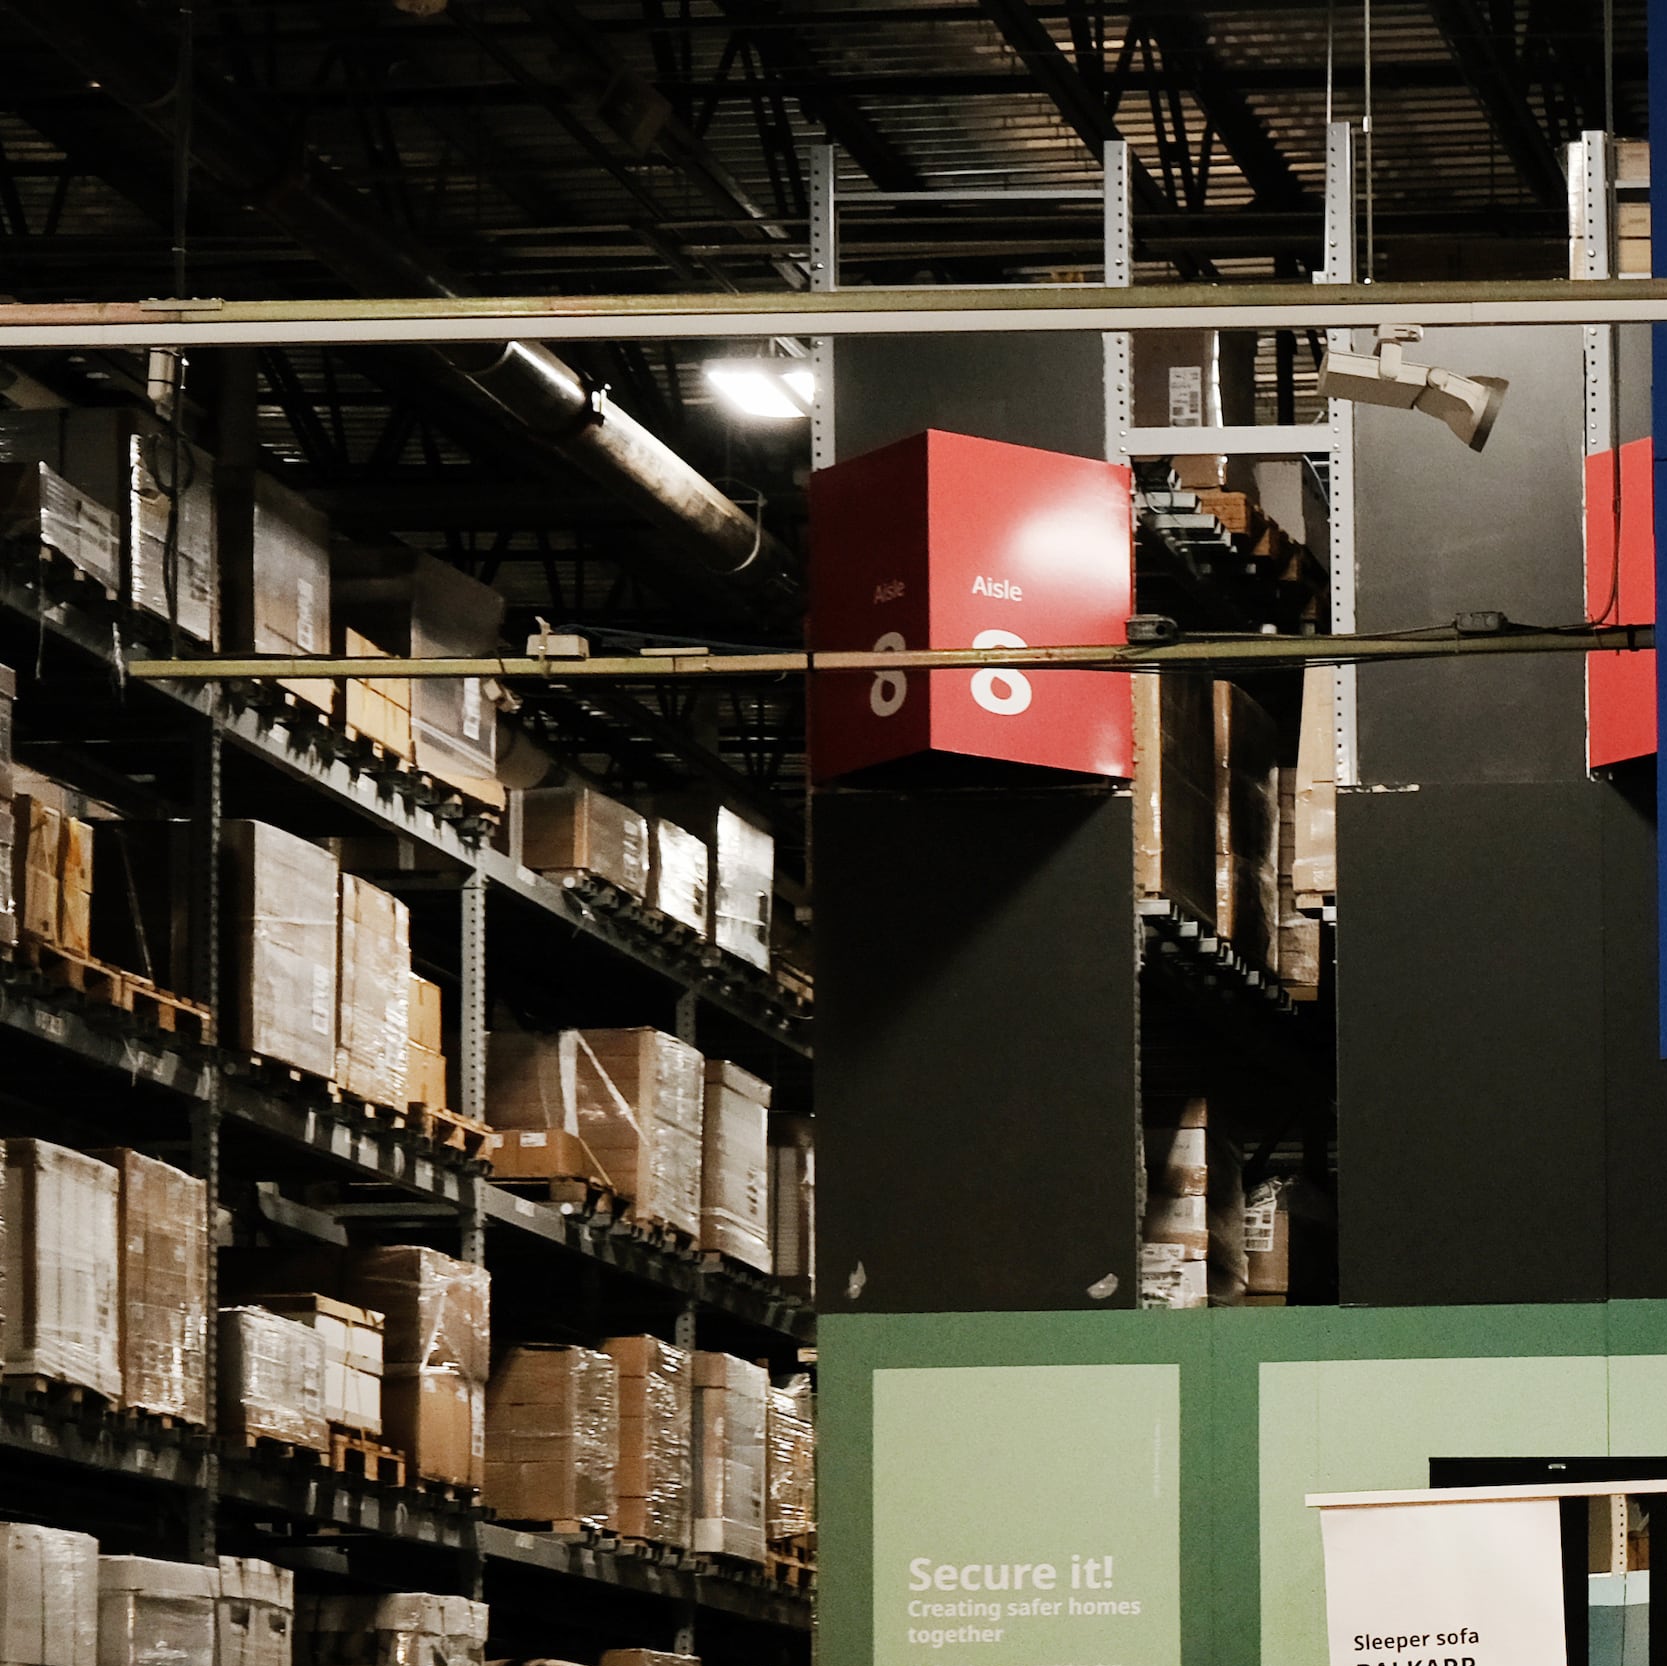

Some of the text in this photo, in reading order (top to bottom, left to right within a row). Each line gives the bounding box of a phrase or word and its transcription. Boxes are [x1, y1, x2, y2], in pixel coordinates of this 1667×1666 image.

[971, 575, 1023, 601] Aisle
[970, 629, 1032, 716] 8
[908, 1554, 1114, 1592] Secure it!
[907, 1597, 1142, 1621] Creating safer homes
[907, 1626, 1004, 1648] together
[1353, 1627, 1480, 1654] Sleeper sofa
